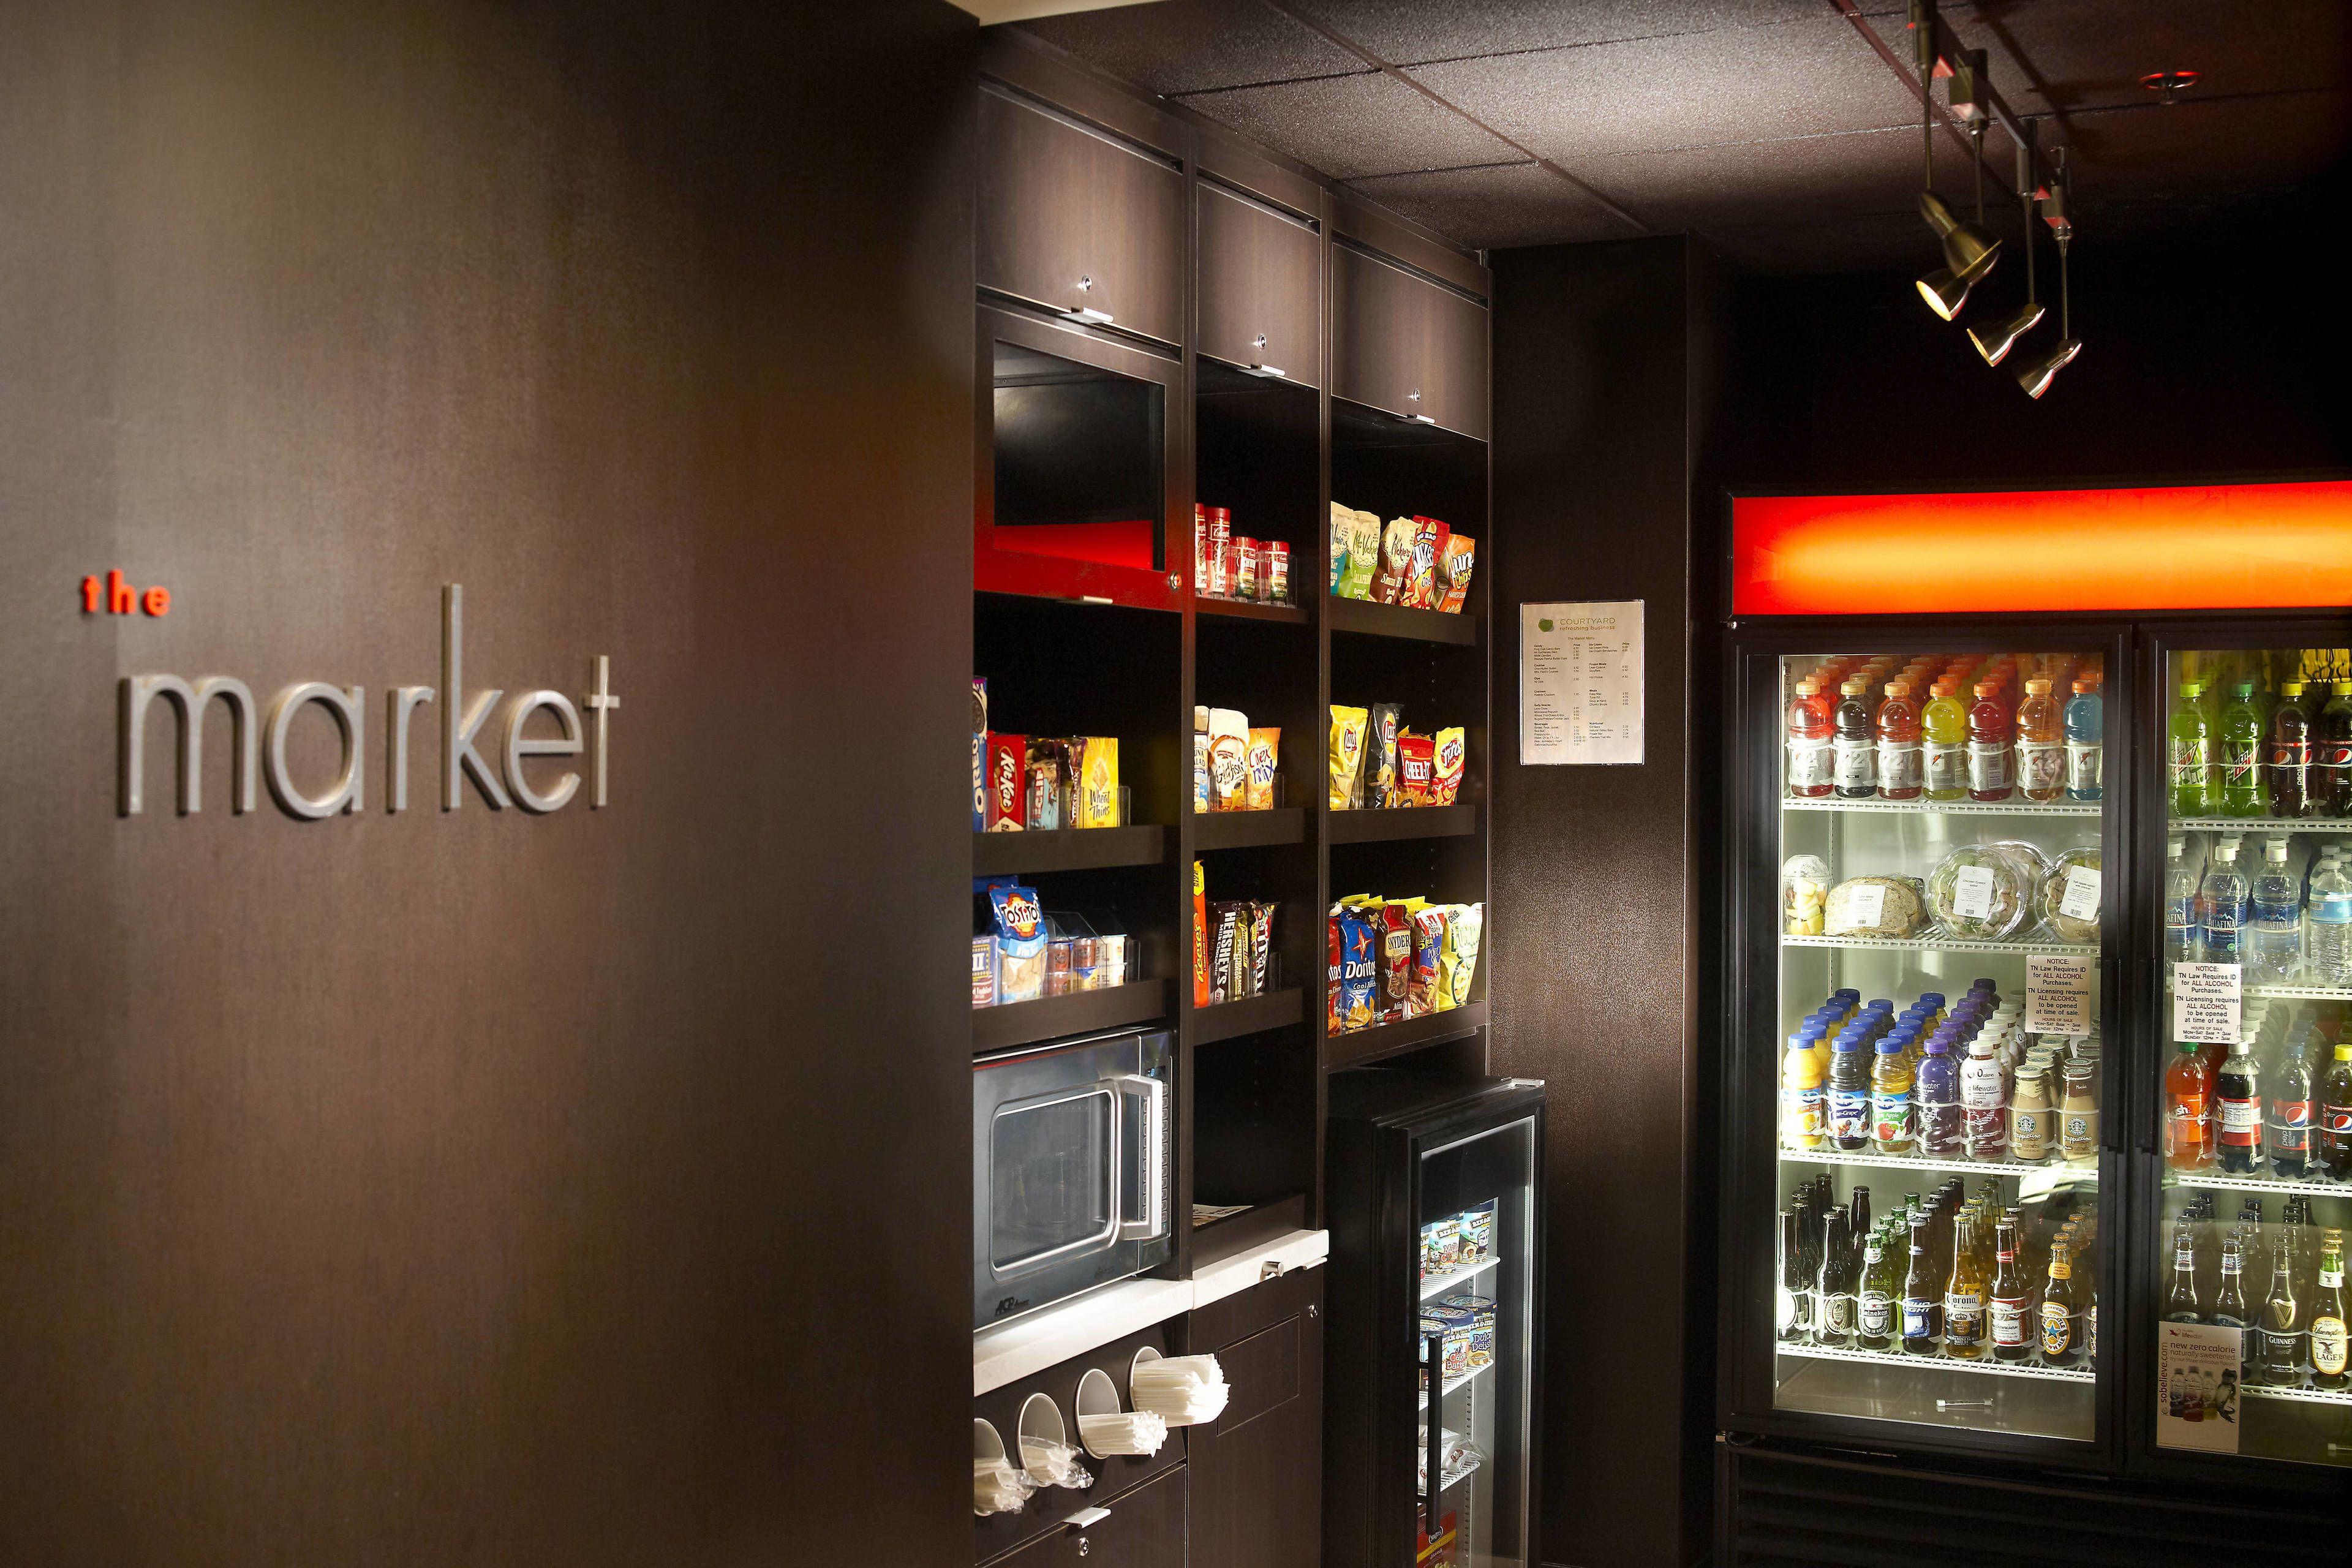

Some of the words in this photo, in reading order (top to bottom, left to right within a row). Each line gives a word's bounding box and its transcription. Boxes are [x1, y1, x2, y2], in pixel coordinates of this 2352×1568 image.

[81, 568, 172, 617] the
[116, 583, 620, 821] market
[1194, 749, 1204, 758] UNA
[1249, 744, 1272, 767] Chex
[1215, 758, 1244, 783] Goldfish
[1090, 788, 1110, 806] Wheat
[1089, 805, 1110, 821] Thins
[2167, 914, 2185, 924] AFINA
[2206, 918, 2236, 929] AQUAFINA
[2258, 920, 2288, 930] AQUAFINA
[1217, 911, 1236, 986] HERSHEY'S
[1328, 964, 1341, 982] itos
[1977, 1069, 1983, 1077] 0
[1947, 1295, 1977, 1305] Corona
[2269, 1336, 2296, 1345] GUINNESS
[2170, 1349, 2199, 1358] naturally
[2190, 1343, 2206, 1351] zero
[2208, 1344, 2236, 1354] calorie
[2316, 1352, 2344, 1361] LAGER
[2159, 1341, 2168, 1403] sobelieve.com
